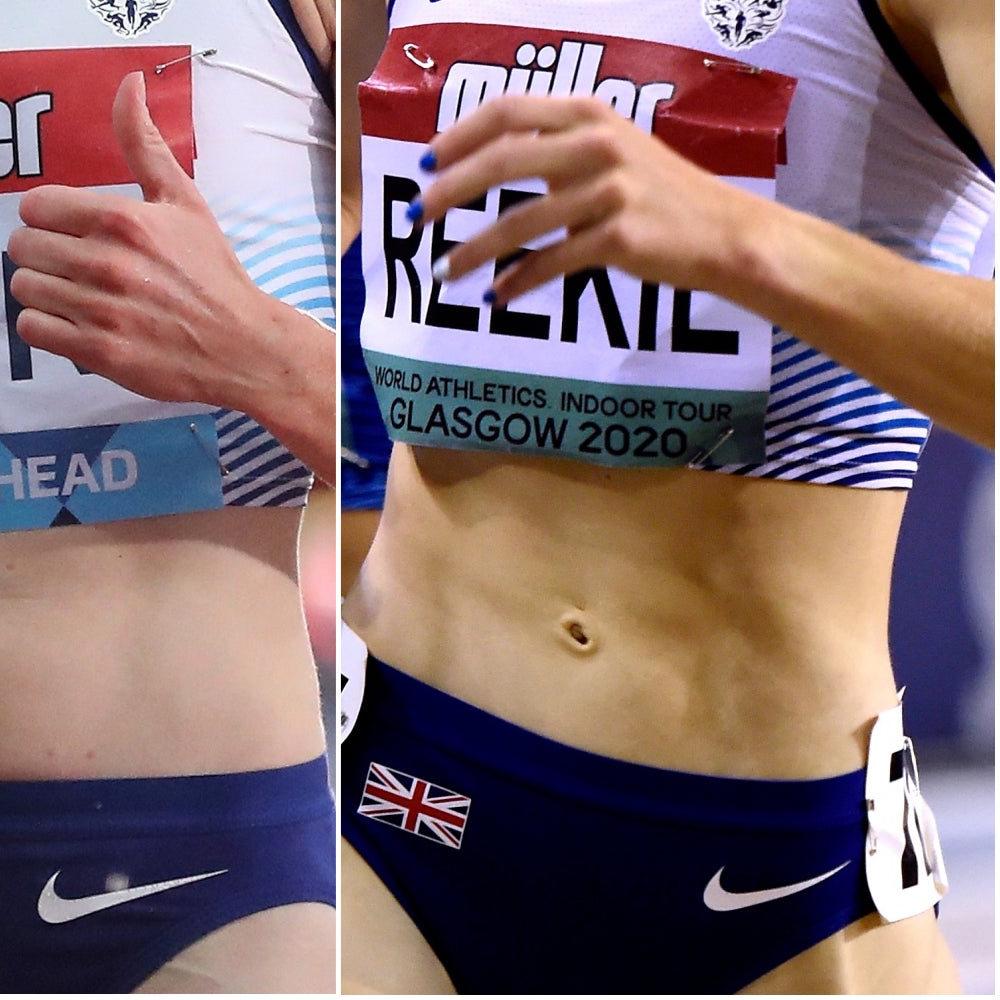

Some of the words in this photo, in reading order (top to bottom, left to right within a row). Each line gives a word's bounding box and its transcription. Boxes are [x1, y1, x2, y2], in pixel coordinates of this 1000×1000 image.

[375, 365, 422, 393] WORLD
[561, 391, 656, 419] INDOOR
[663, 401, 732, 423] TOUR
[390, 397, 568, 449] GLASGOW
[578, 421, 688, 459] 2020
